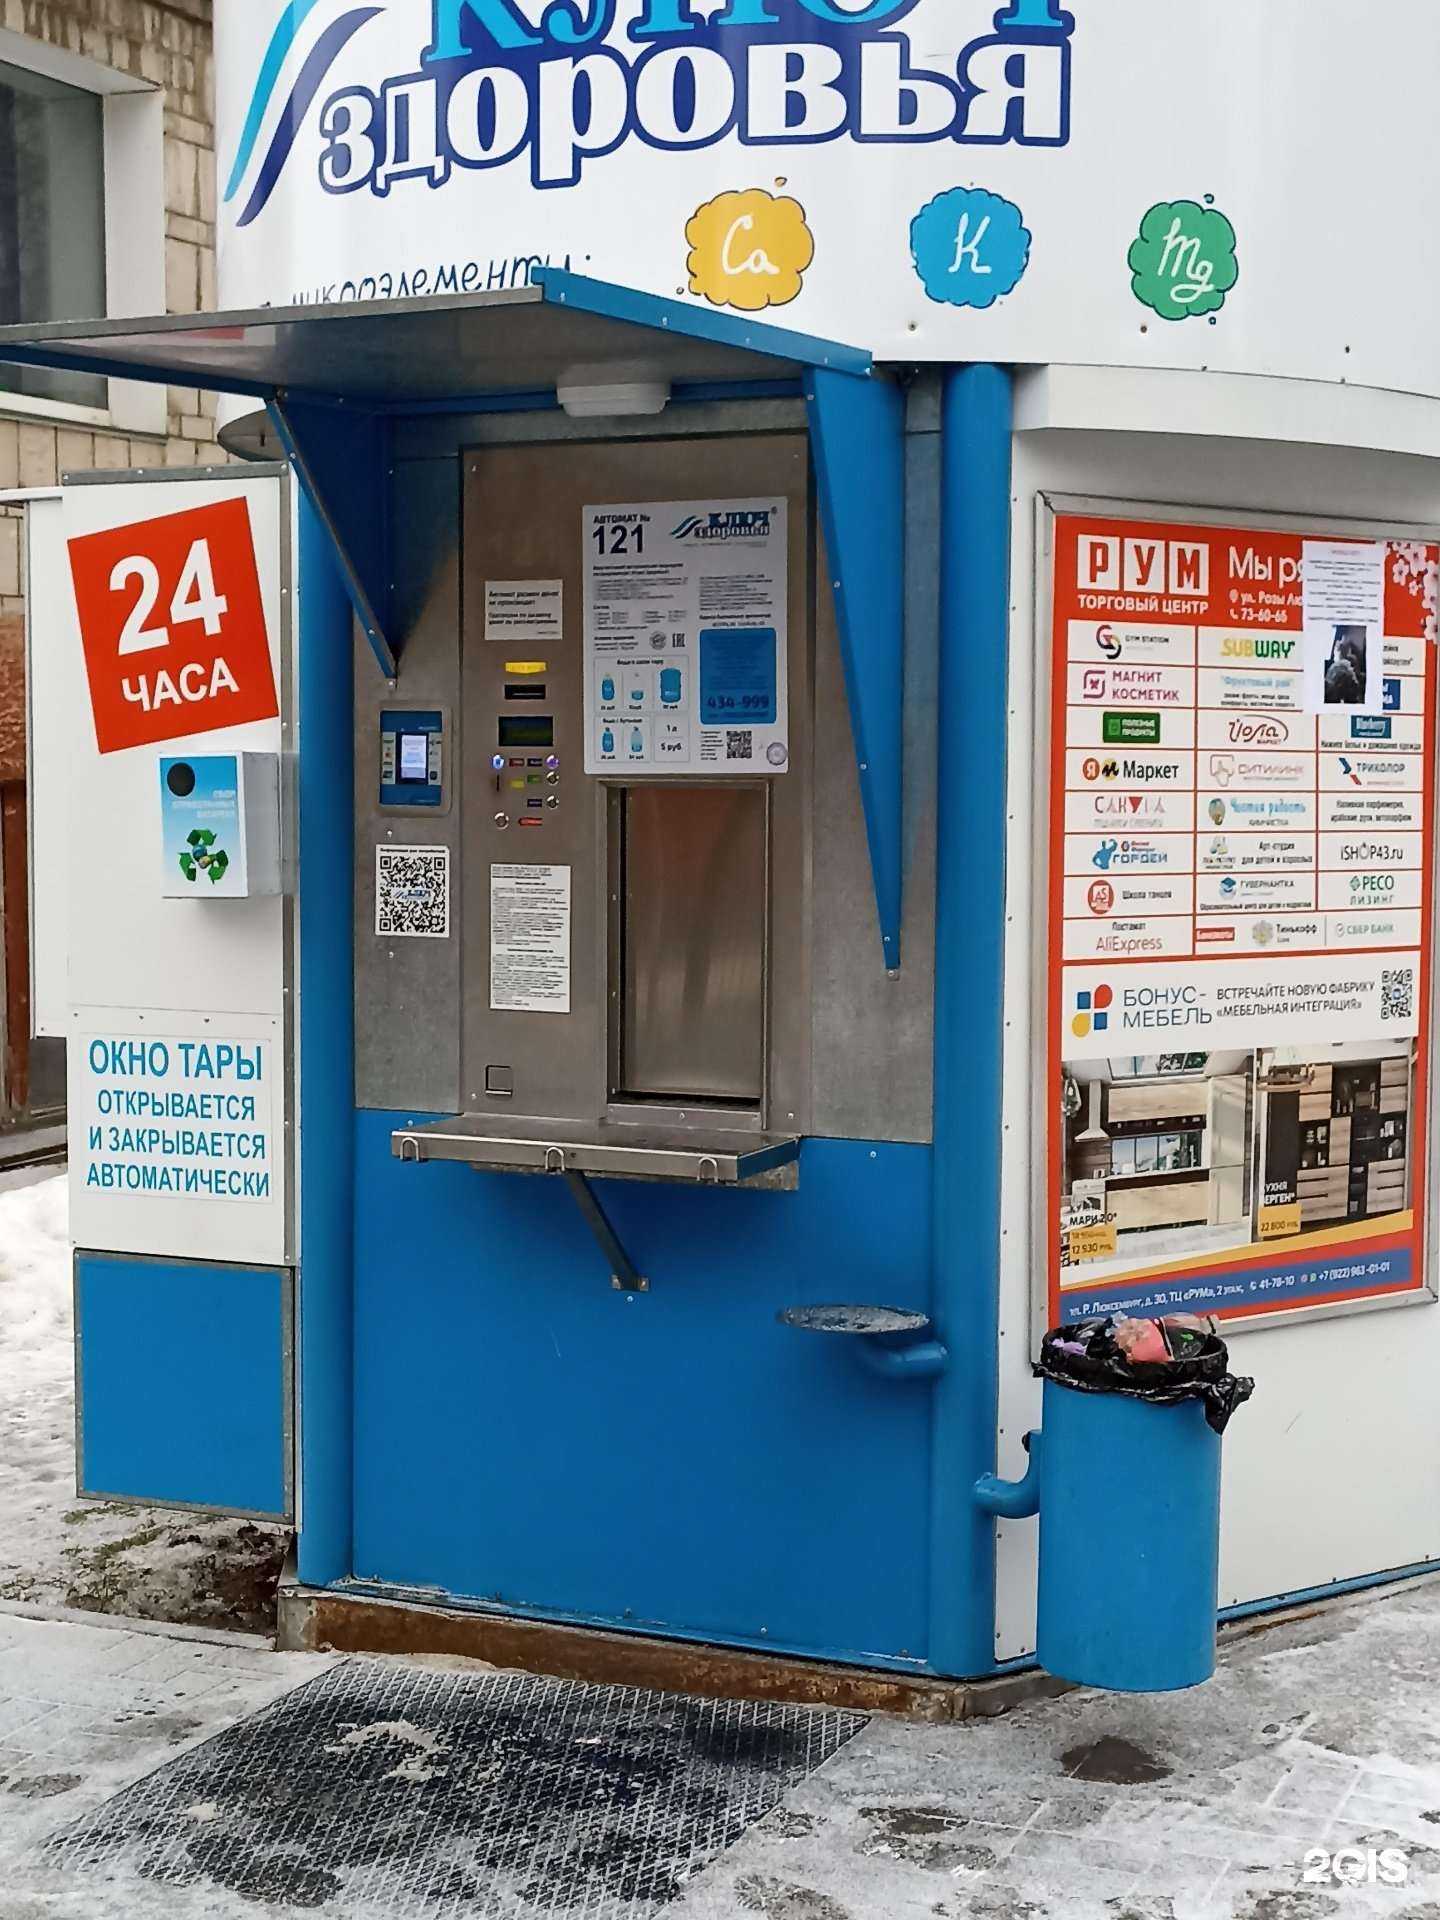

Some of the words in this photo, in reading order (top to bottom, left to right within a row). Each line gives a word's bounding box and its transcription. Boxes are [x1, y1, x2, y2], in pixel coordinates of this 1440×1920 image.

[320, 38, 1064, 192] здоровья
[721, 213, 780, 276] Ca
[948, 212, 993, 275] K
[1155, 216, 1215, 304] Mg
[593, 513, 638, 524] АВТОМАТ
[592, 523, 644, 555] 121
[1087, 540, 1202, 590] РУМ
[1228, 545, 1272, 581] Мы
[108, 537, 229, 657] 24
[1077, 594, 1159, 612] ТОРГОВЫЙ
[1161, 599, 1209, 615] ЦЕНТР
[1220, 638, 1296, 659] SUBWAY
[121, 656, 241, 712] ЧАСА
[1112, 670, 1163, 683] МАГНИТ
[708, 695, 770, 710] 434-999
[1111, 688, 1180, 701] КОСМЕТИК
[661, 742, 667, 751] 5
[667, 742, 682, 753] руб
[1122, 759, 1180, 782] Маркет
[1356, 762, 1406, 773] ТРИКОЛОР
[1340, 842, 1404, 861] iSHOP43.ru
[1362, 874, 1395, 891] РЕСО
[1349, 894, 1395, 906] ЛИЗИНГ
[1276, 923, 1318, 934] Тинькофф
[1095, 935, 1164, 955] AliExpress
[1123, 984, 1207, 1007] БОНУС-
[1216, 983, 1286, 1000] ВСТРЕЧАЙТЕ
[1287, 982, 1328, 996] НОВУЮ
[1328, 980, 1375, 995] ФАБРИКУ
[1123, 1007, 1213, 1028] МЕБЕЛЬ
[1216, 1001, 1289, 1017] «МЕБЕЛЬНАЯ
[1290, 998, 1362, 1014] ИНТЕГРАЦИЯ»
[88, 1039, 170, 1077] ОКНО
[177, 1043, 262, 1081] ТАРЫ
[97, 1088, 256, 1121] ОТКРЫВАЕТСЯ
[88, 1126, 102, 1151] И
[107, 1126, 266, 1160] ЗАКРЫВАЕТСЯ
[86, 1162, 270, 1198] АВТОМАТИЧЕСКИ
[1170, 1291, 1182, 1303] ТЦ
[1216, 1285, 1223, 1296] 2
